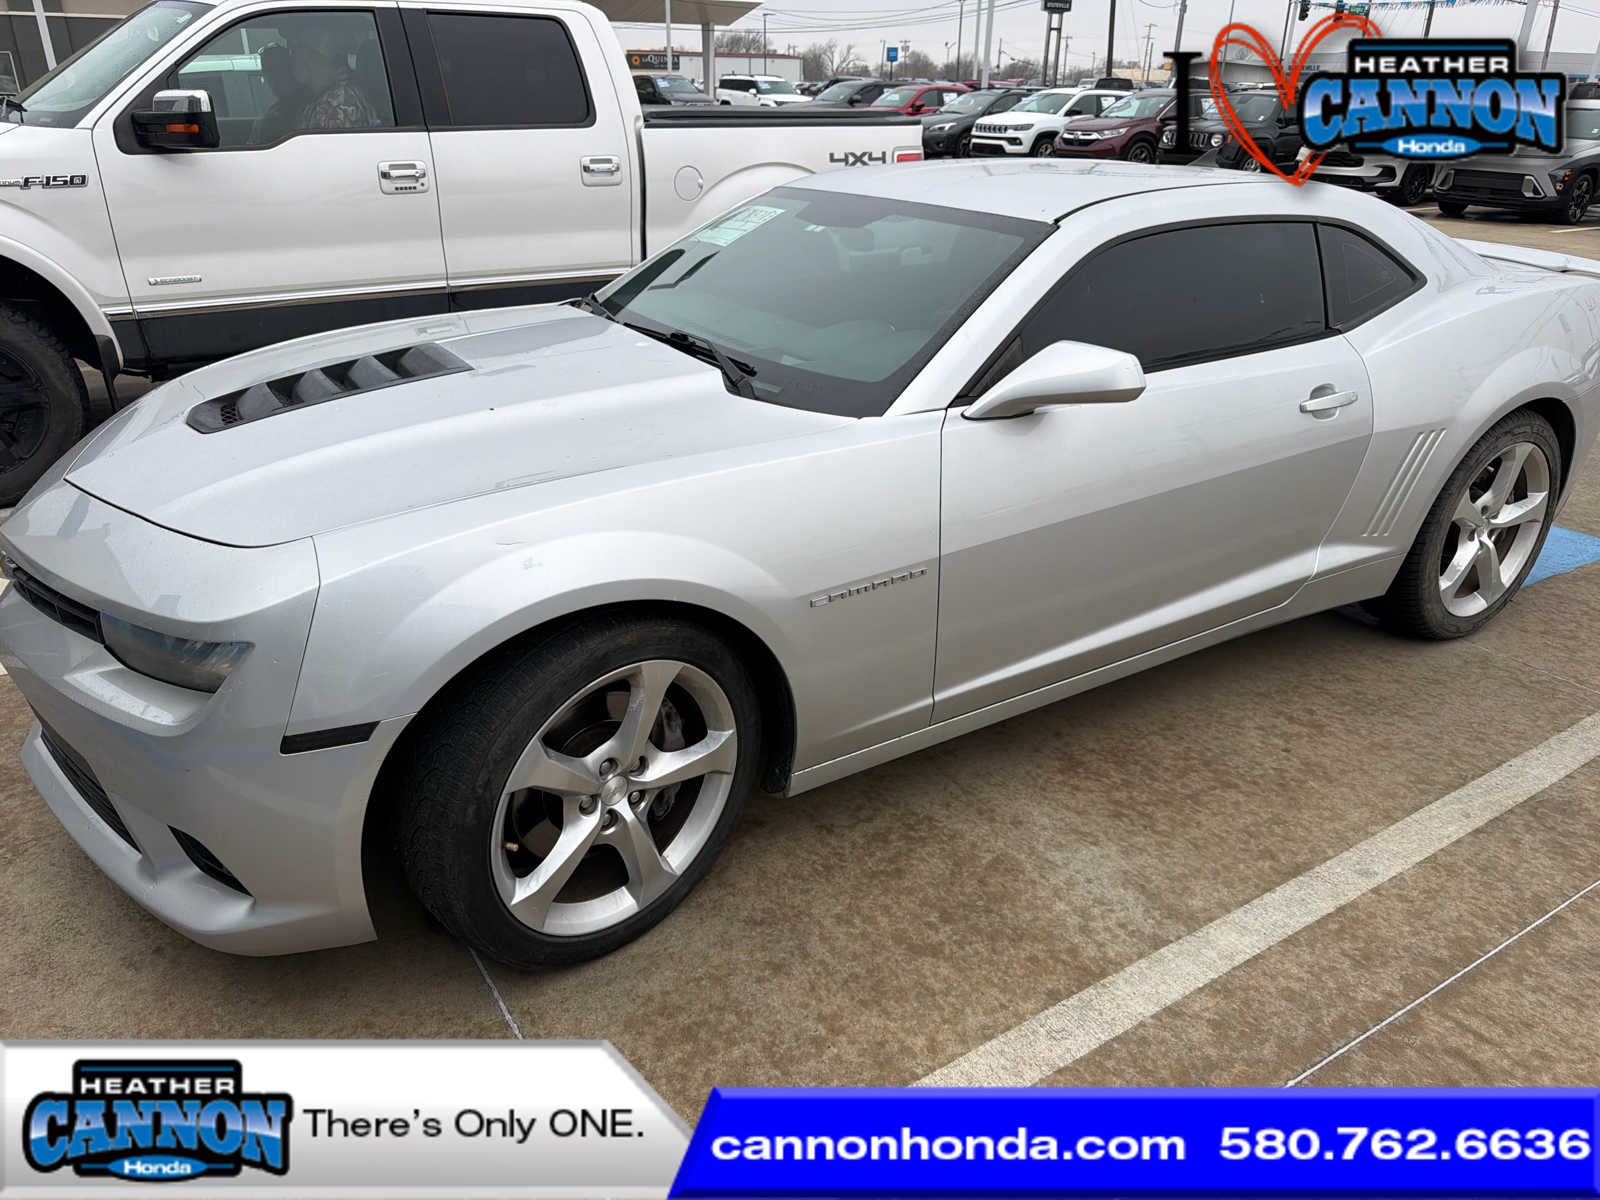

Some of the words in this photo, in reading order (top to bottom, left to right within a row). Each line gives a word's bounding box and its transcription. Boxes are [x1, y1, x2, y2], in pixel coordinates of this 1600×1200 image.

[648, 54, 679, 64] QUINA
[22, 174, 88, 190] F-150
[809, 567, 928, 608] CAMARO
